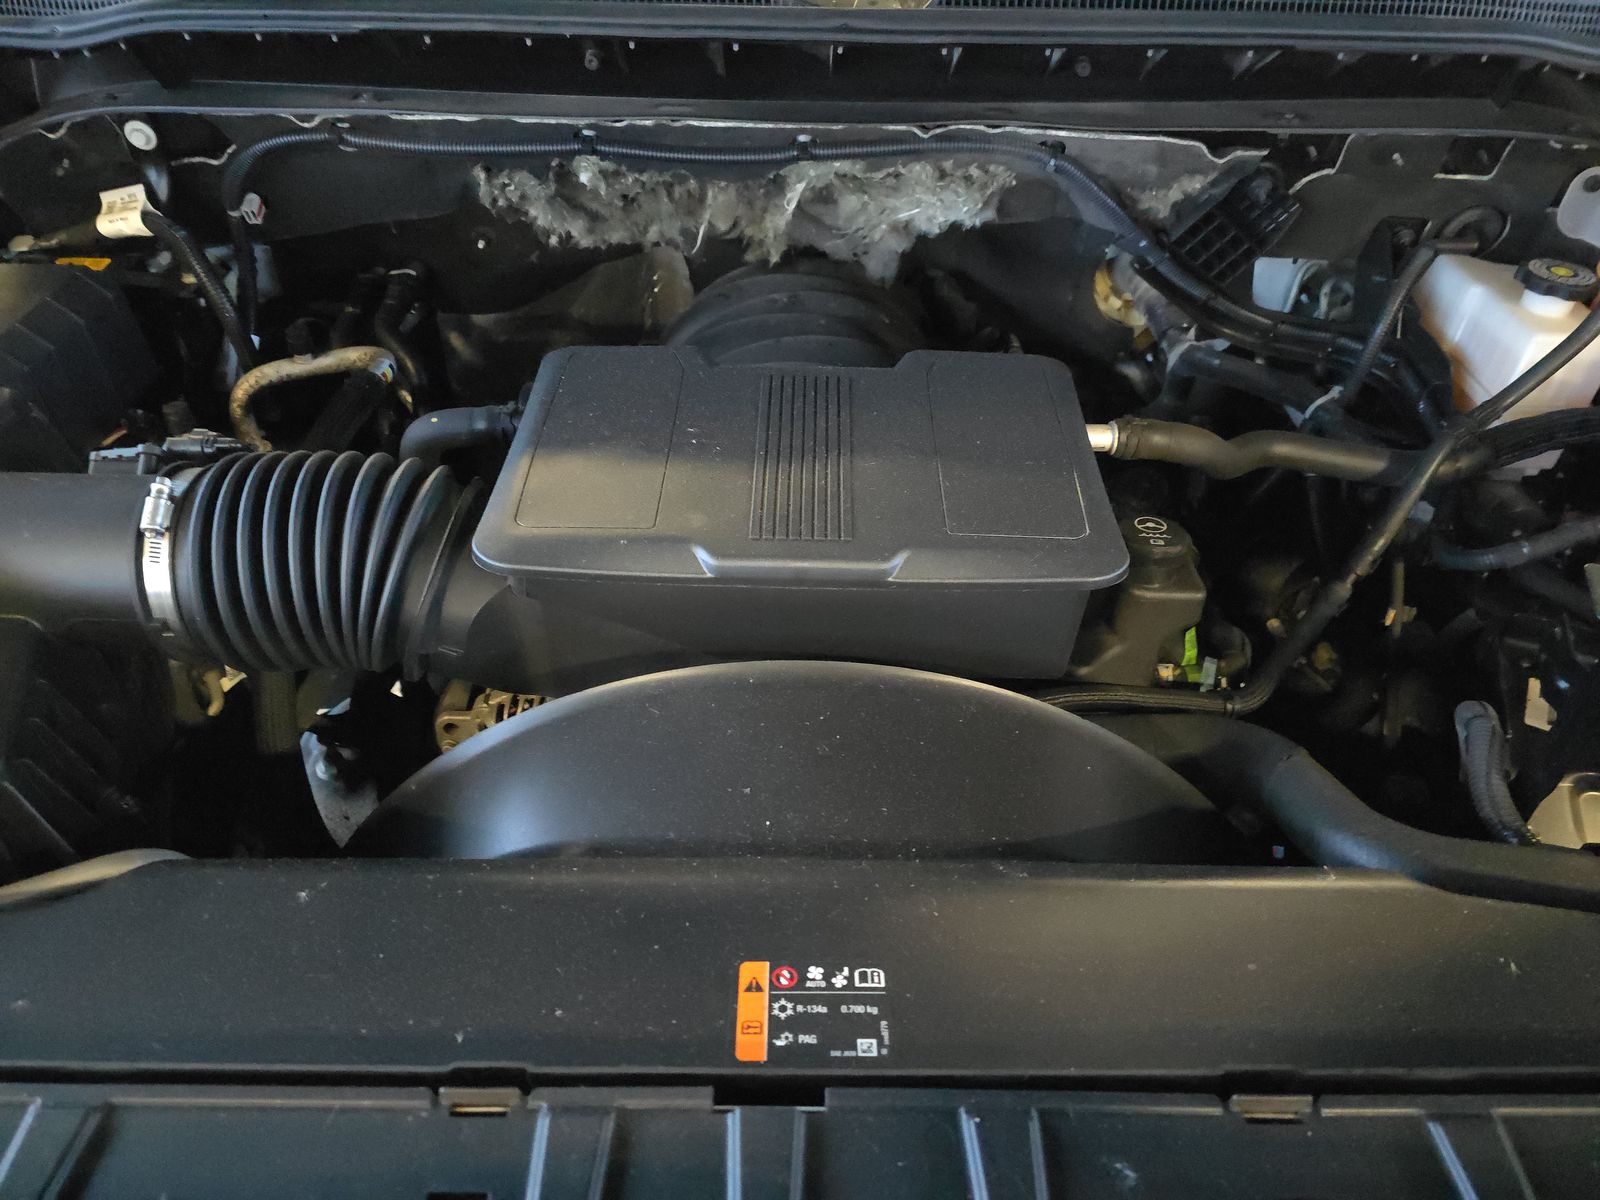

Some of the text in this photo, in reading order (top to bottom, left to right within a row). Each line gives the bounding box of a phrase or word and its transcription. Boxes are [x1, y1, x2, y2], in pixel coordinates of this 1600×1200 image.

[805, 980, 826, 988] AUTO
[796, 1004, 828, 1013] R-134a
[866, 1004, 879, 1015] kg
[798, 1034, 817, 1044] PAG
